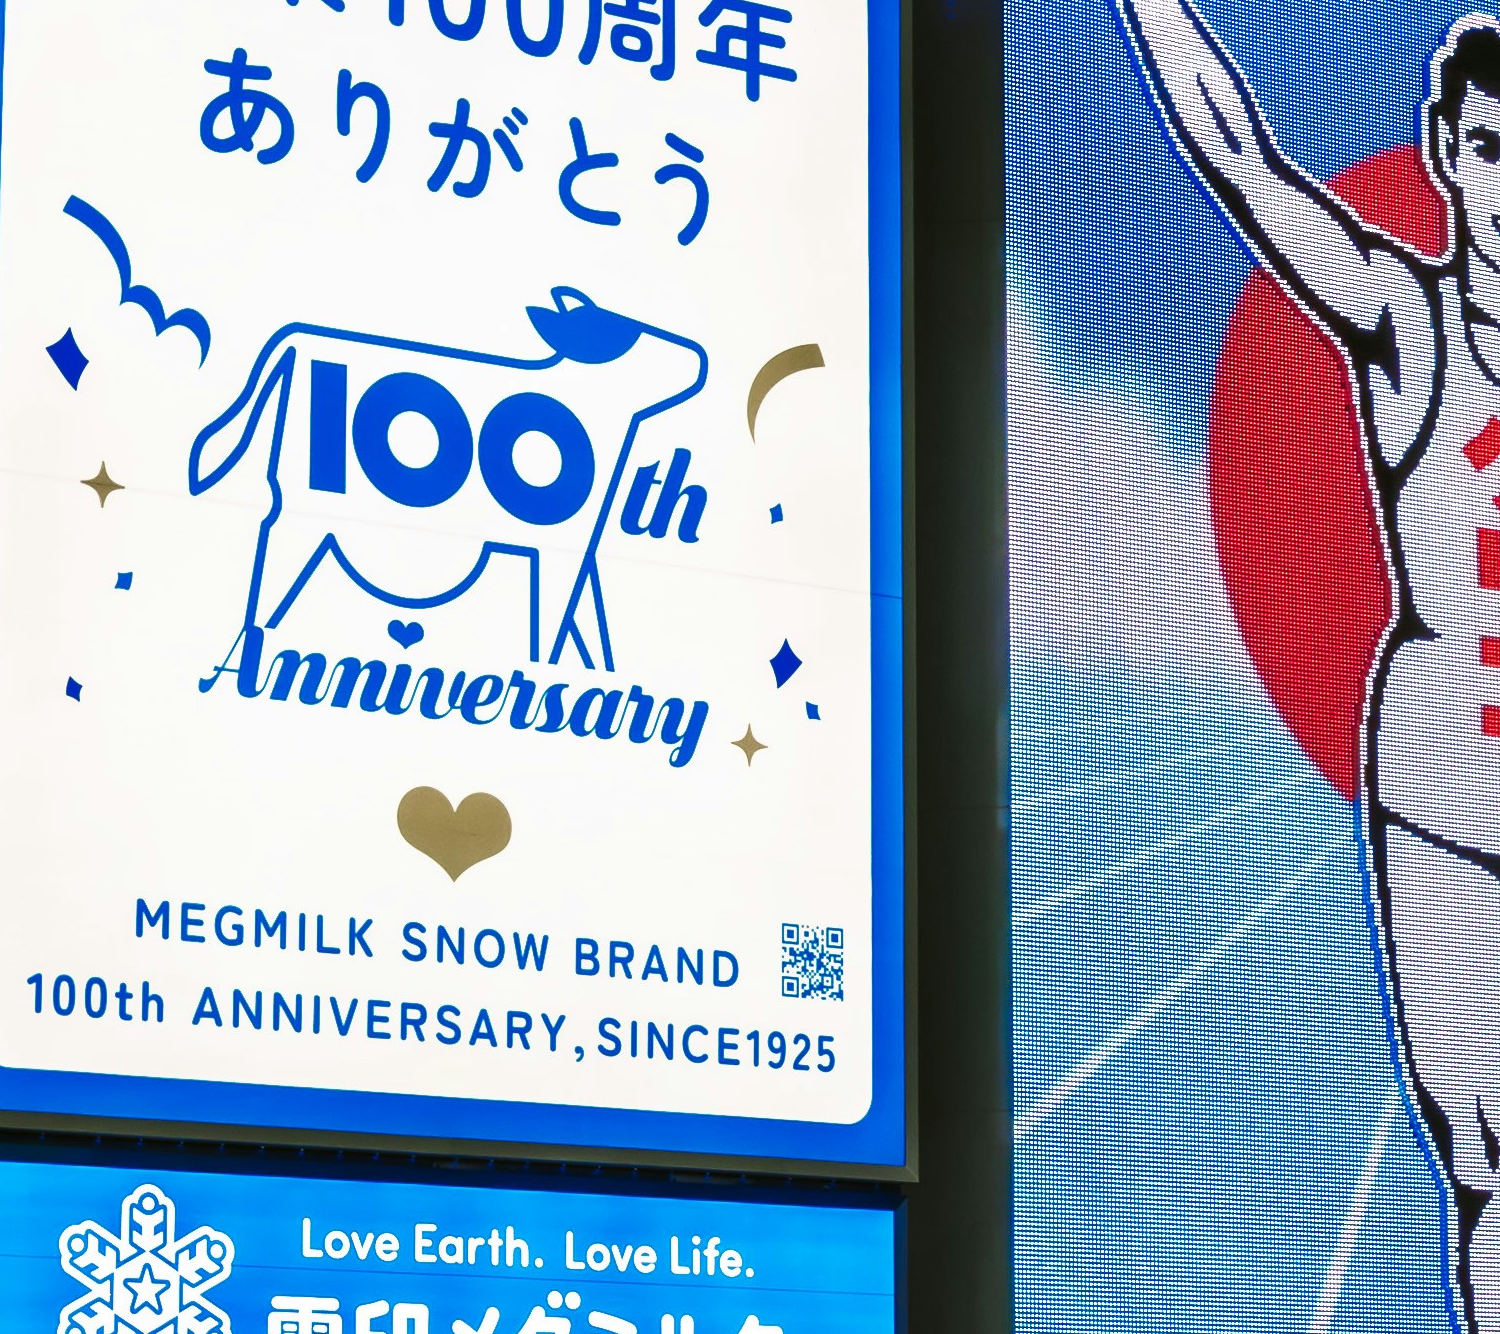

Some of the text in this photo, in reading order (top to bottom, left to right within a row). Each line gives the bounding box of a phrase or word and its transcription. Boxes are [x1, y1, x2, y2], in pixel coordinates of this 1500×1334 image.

[197, 46, 713, 248] ありがとう
[197, 624, 712, 769] Anniversary
[133, 897, 742, 990] MEGMILK SNOW BRAND
[24, 972, 166, 1024] 100th
[299, 1217, 757, 1280] Love Earth. Love Life.
